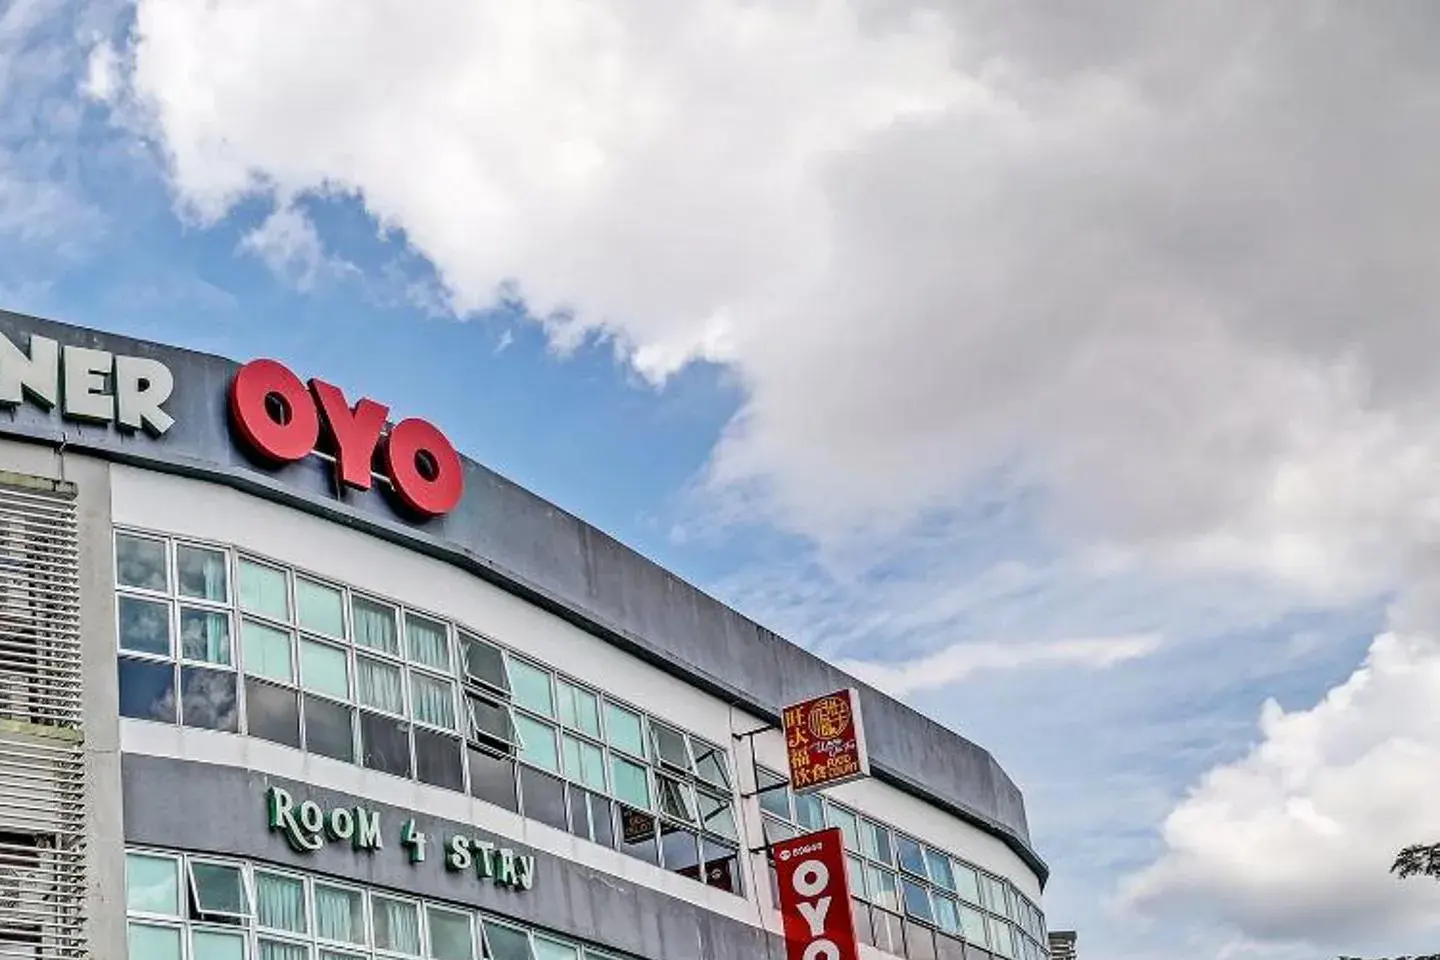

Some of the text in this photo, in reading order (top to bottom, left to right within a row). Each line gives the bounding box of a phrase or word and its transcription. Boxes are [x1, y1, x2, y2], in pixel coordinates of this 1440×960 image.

[229, 358, 465, 518] OYO
[402, 818, 426, 863] 4
[446, 834, 535, 891] STAY
